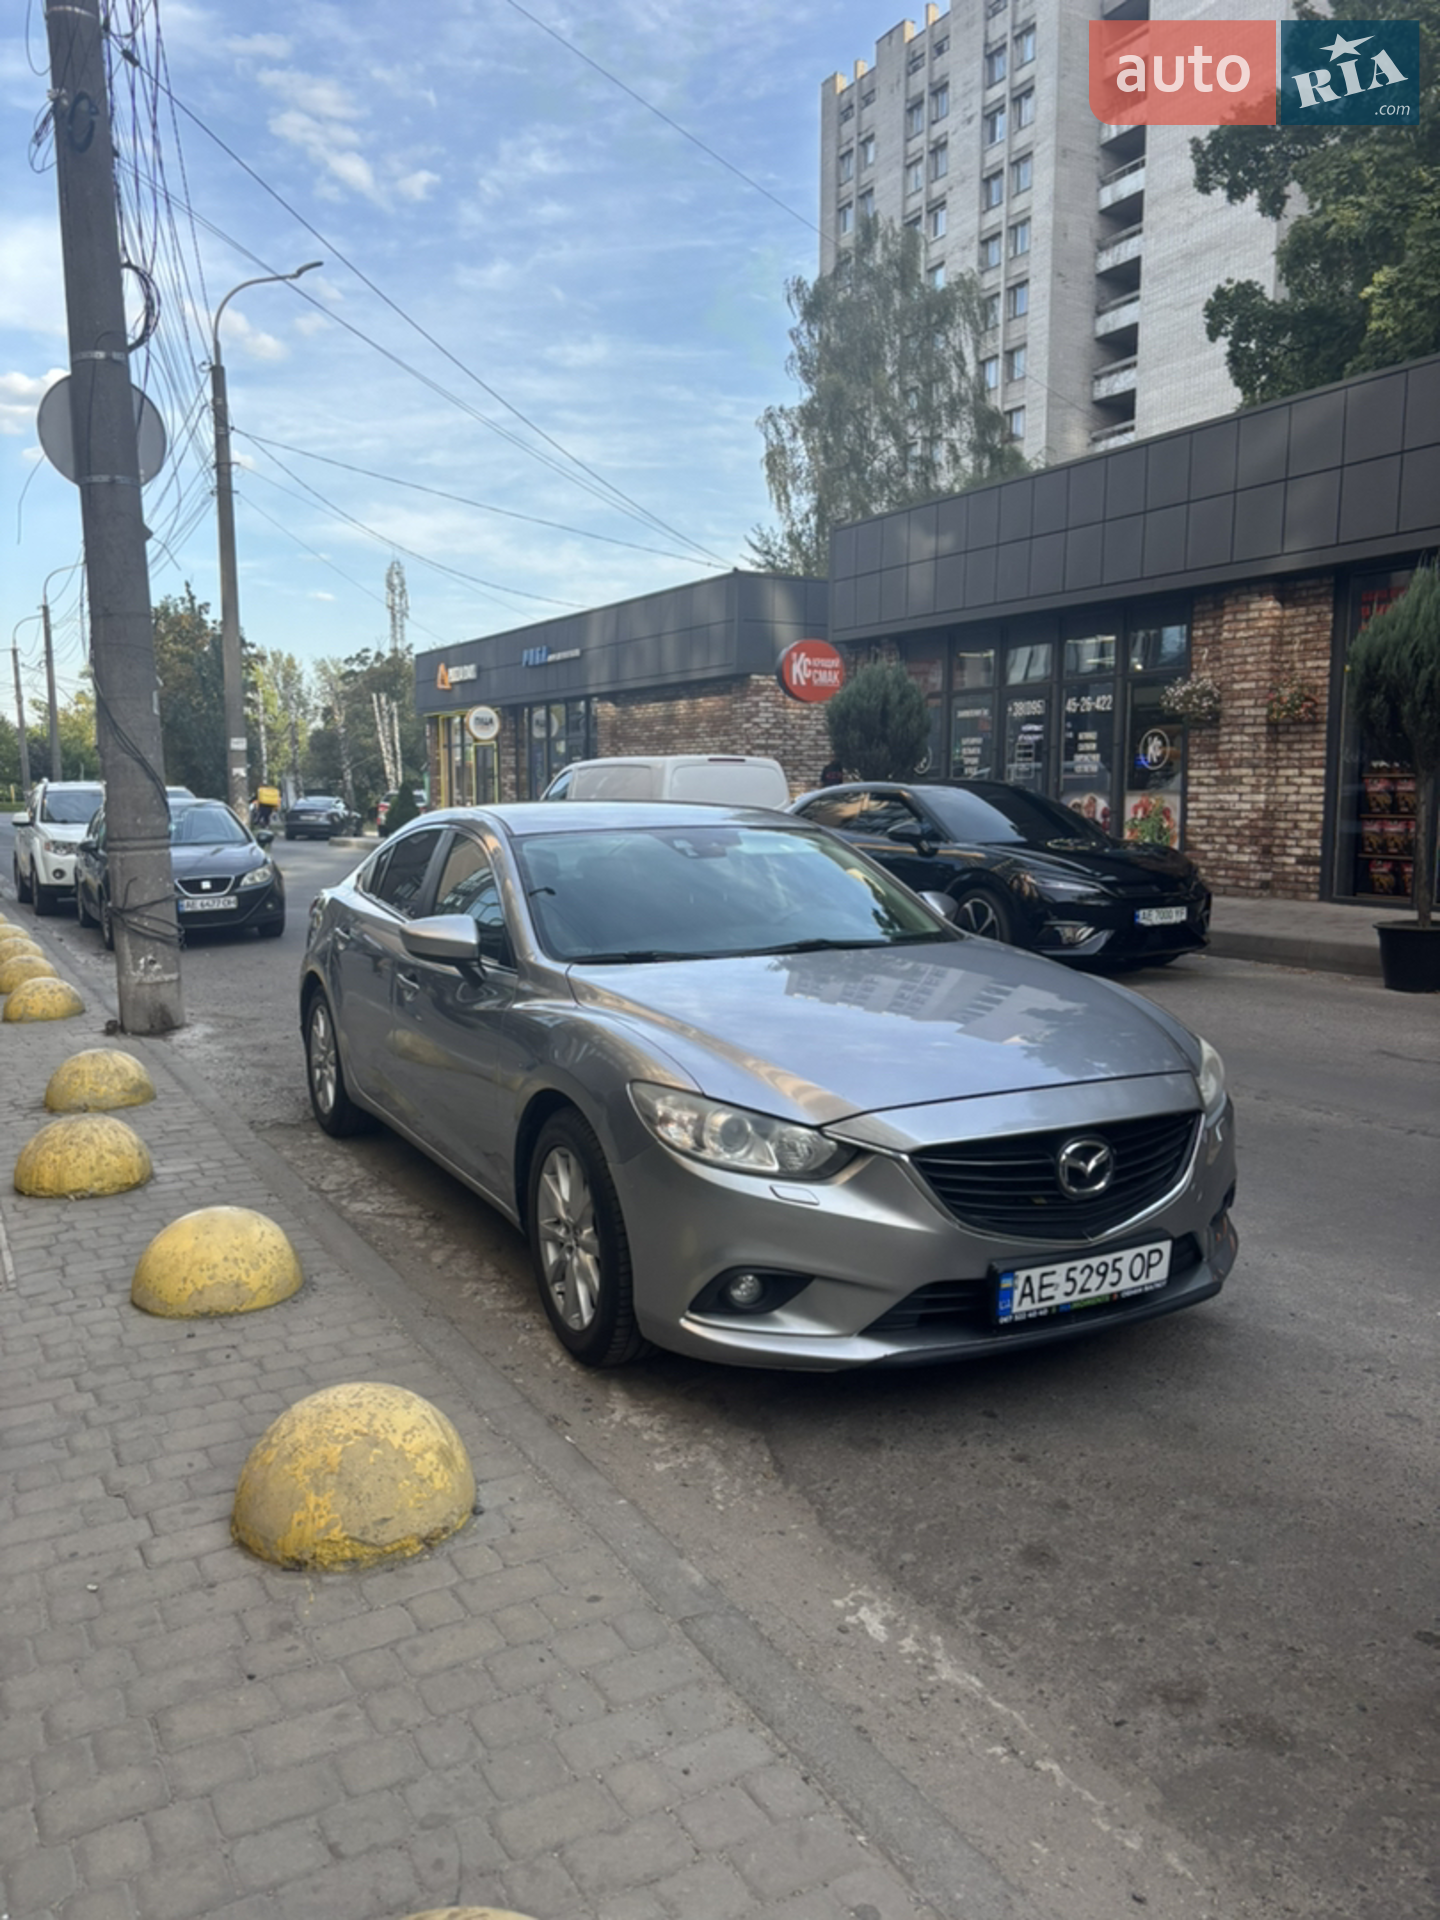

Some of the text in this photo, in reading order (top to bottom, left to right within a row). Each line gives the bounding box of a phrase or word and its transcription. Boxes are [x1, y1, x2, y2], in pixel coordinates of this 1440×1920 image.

[812, 669, 840, 684] СМАК
[1065, 695, 1113, 713] 45-26-422
[1018, 1271, 1056, 1307] AE
[1063, 1257, 1123, 1297] 5295
[1129, 1248, 1163, 1282] OP
